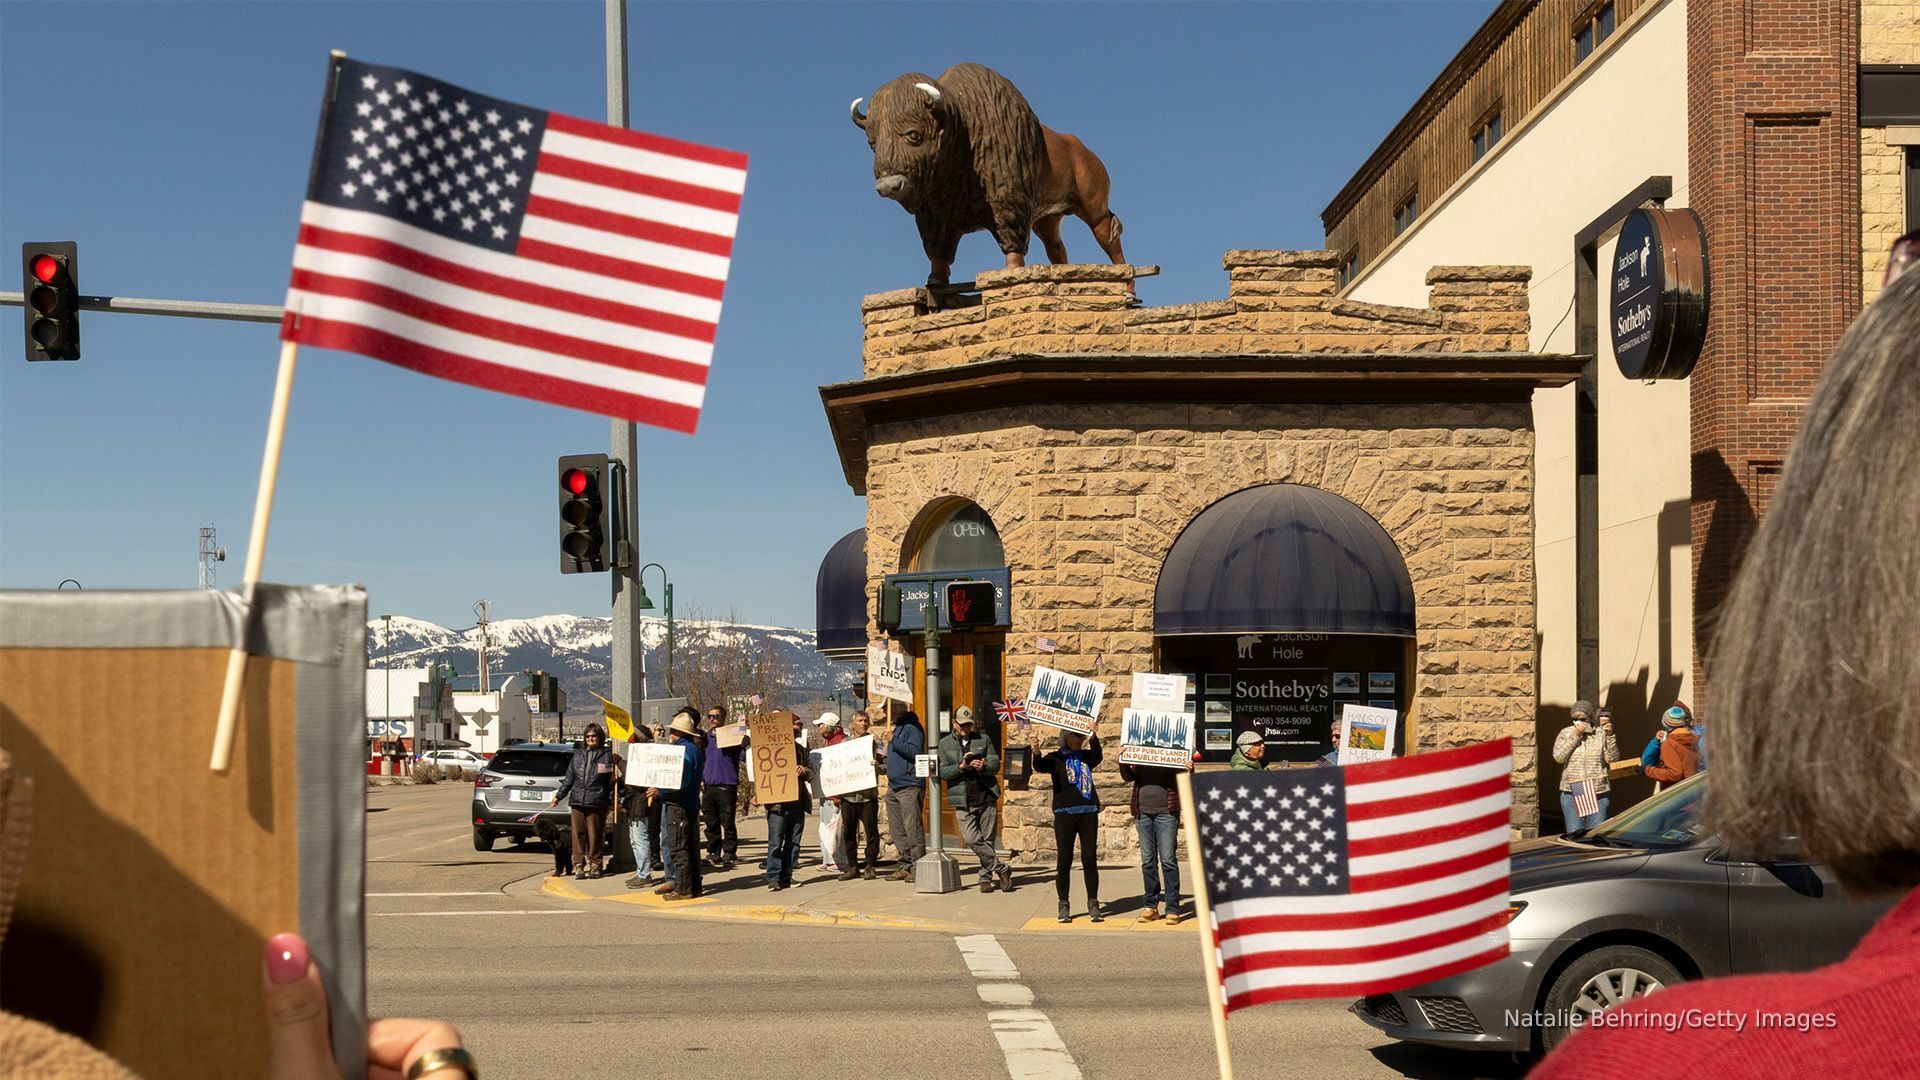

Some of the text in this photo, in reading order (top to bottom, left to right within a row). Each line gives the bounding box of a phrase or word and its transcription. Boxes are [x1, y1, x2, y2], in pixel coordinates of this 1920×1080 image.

[1618, 249, 1638, 272] Jackson
[1617, 275, 1630, 293] Hole
[1617, 304, 1651, 337] Sotheby's
[953, 521, 985, 537] OPEN
[1273, 647, 1304, 659] Hole
[1236, 679, 1328, 702] Sotheby's
[752, 715, 777, 725] SAVE
[1028, 708, 1090, 731] IN PUBLIC HANDS
[1030, 702, 1091, 725] KEEP PUBLIC LANDS
[1253, 717, 1312, 726] (208) 354-9090
[757, 725, 779, 734] PBS
[768, 733, 791, 743] NPR
[757, 746, 788, 772] 86
[1133, 754, 1159, 762] PUBLIC
[1160, 756, 1187, 765] HANDS
[1142, 747, 1164, 755] PUBLIC
[1165, 749, 1188, 757] LANDS
[760, 773, 788, 797] 47
